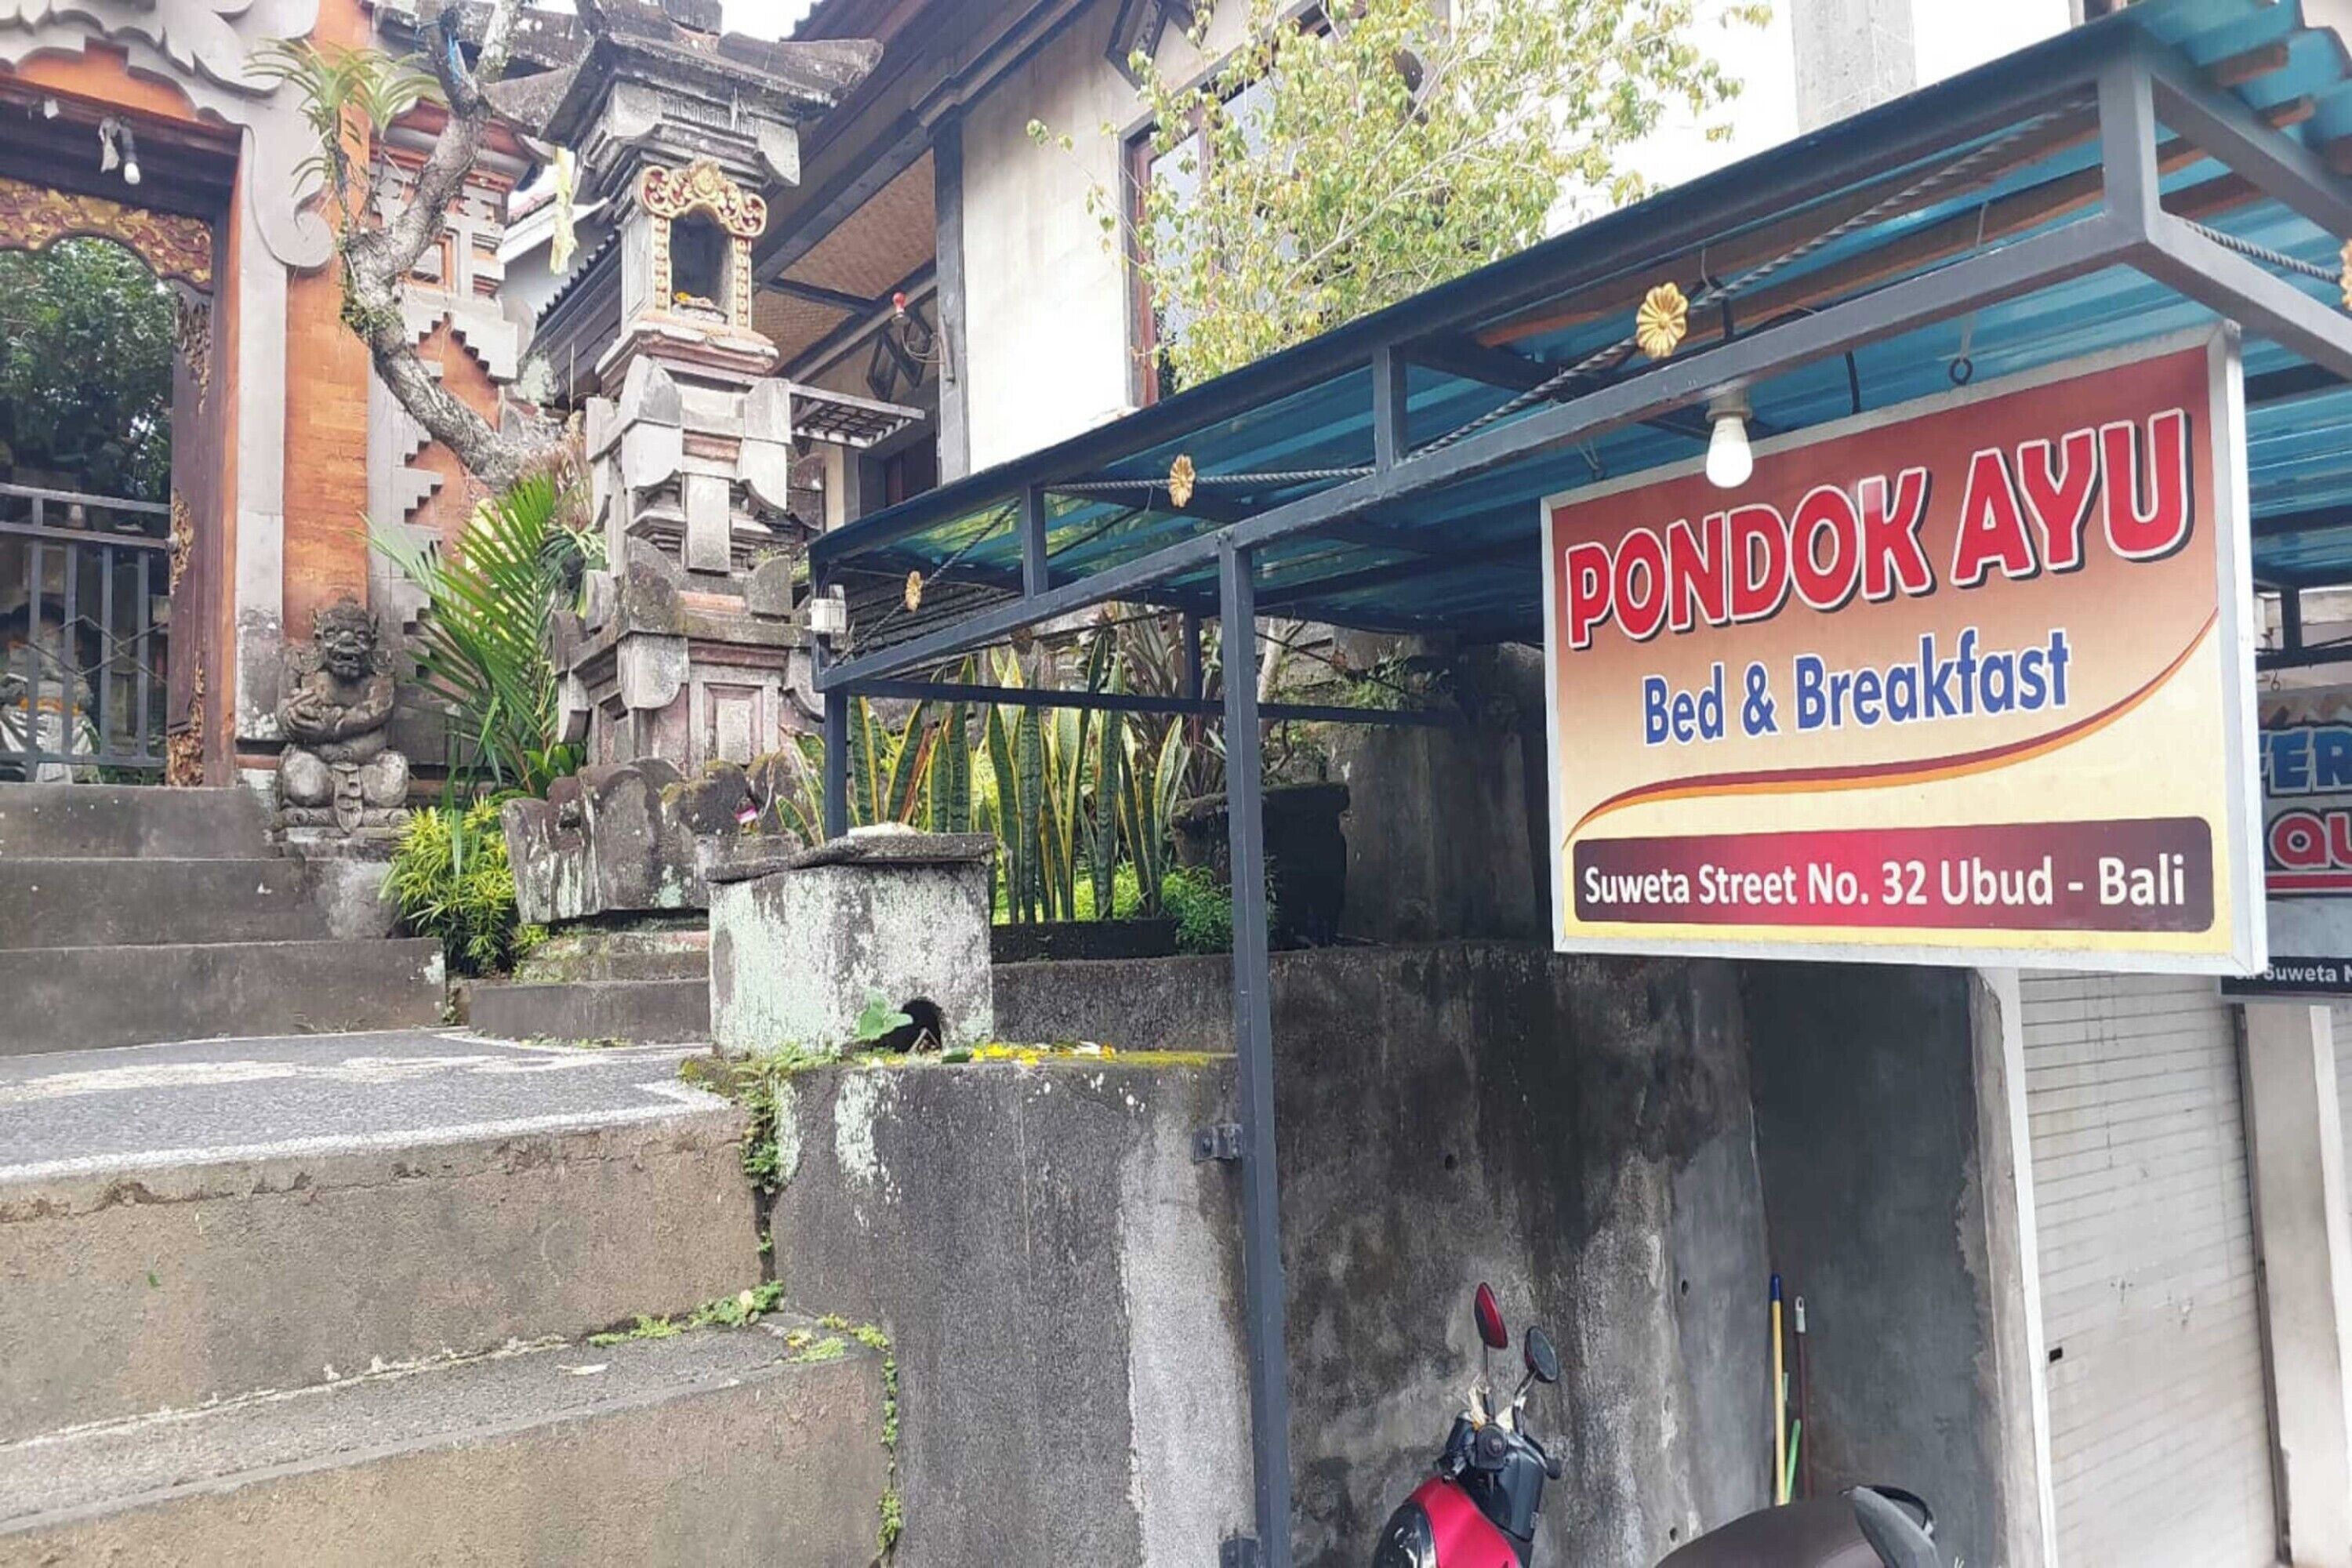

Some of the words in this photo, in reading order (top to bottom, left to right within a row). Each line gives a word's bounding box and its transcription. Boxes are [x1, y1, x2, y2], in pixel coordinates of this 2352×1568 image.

[1565, 466, 1935, 649] PONDOK
[1949, 408, 2193, 588] AYU
[1642, 662, 1726, 746] Bed
[1740, 660, 1778, 737] &
[1794, 627, 2071, 729] Breakfast
[1584, 866, 1690, 904] Suweta
[1698, 863, 1798, 905] Street
[1807, 862, 1869, 905] No.
[1882, 860, 1928, 905] 32
[1941, 855, 2054, 906] Ubud
[2068, 881, 2084, 891] -
[2099, 853, 2186, 906] Bali
